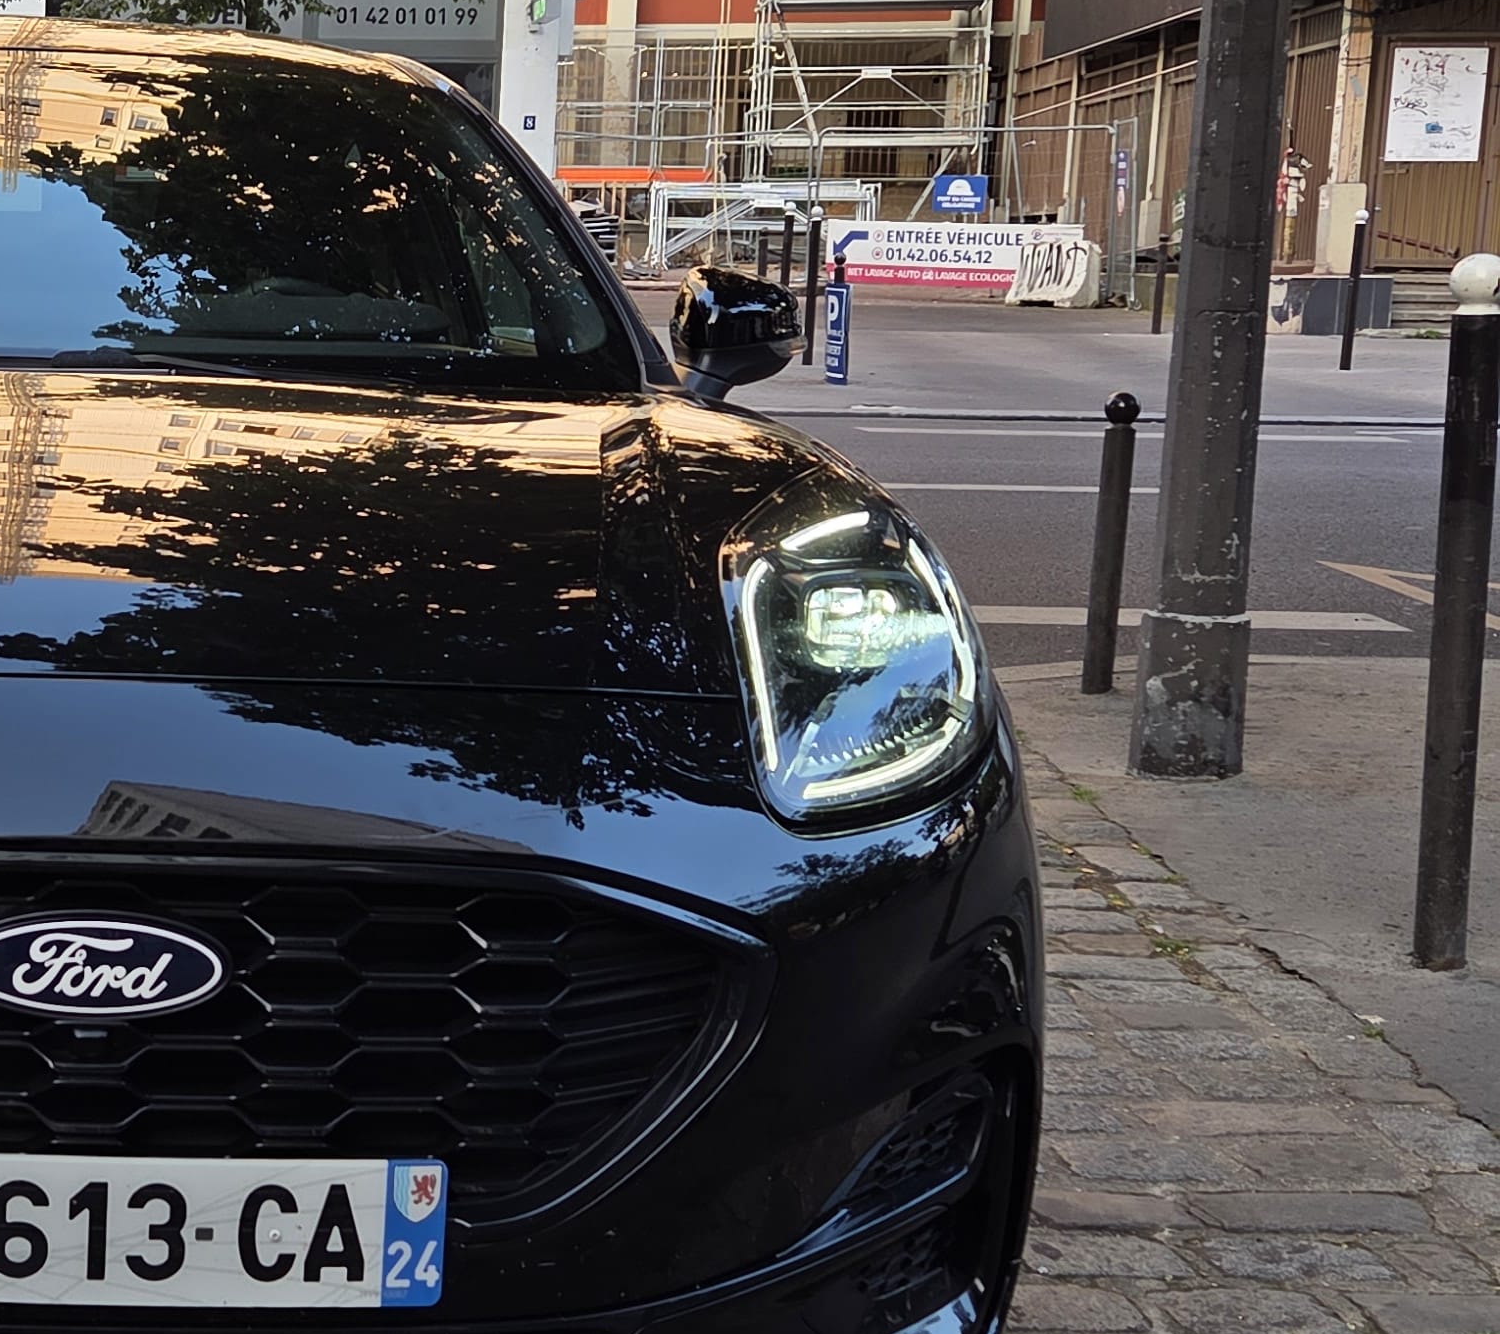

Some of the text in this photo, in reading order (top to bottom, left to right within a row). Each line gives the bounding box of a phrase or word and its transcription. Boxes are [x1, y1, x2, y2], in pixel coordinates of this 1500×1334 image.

[336, 7, 478, 25] 01 42 01 01 99
[886, 228, 942, 244] ENTRÉE
[946, 229, 1024, 247] VÉHICULE
[885, 247, 993, 264] 01.42.06.54.12
[935, 270, 967, 281] LAVAGE
[827, 295, 839, 331] P
[12, 932, 174, 999] Ford
[385, 1240, 440, 1288] 24
